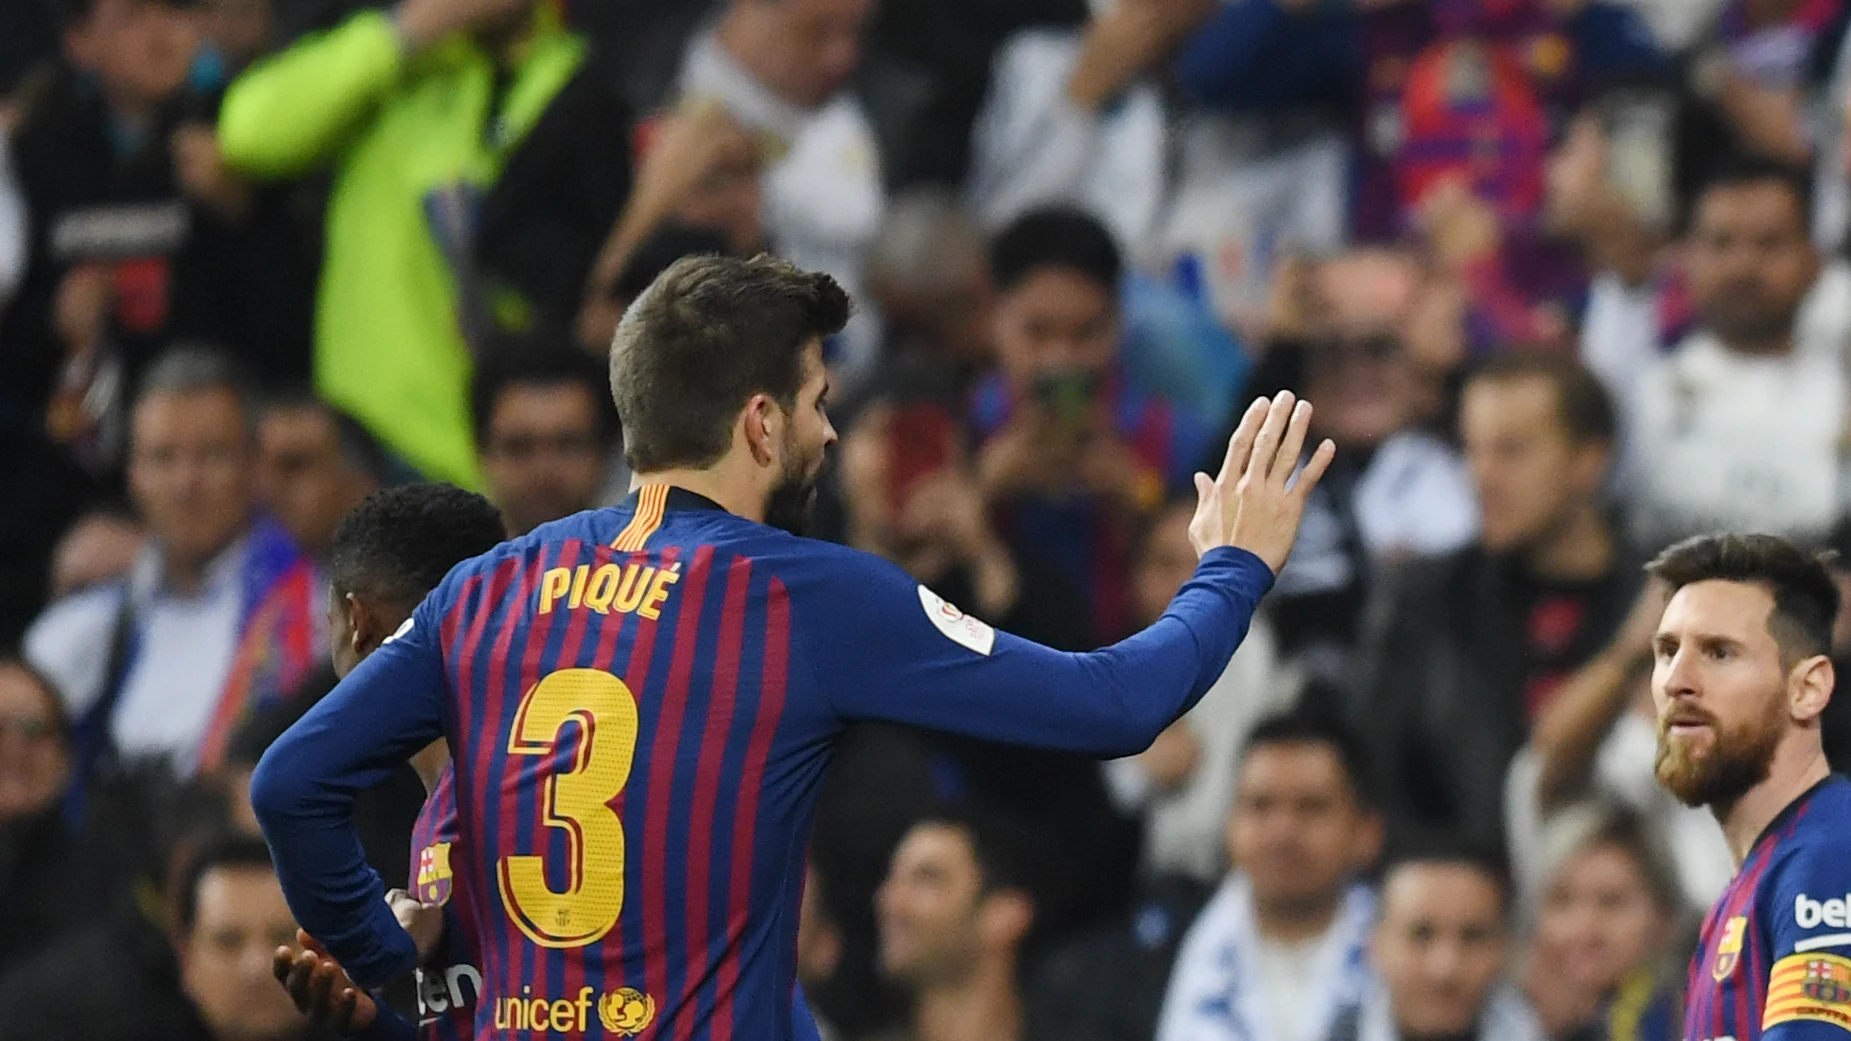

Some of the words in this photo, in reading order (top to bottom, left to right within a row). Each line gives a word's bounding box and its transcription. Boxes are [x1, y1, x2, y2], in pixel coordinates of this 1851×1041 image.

[538, 561, 682, 621] PIQUÉ
[496, 667, 639, 949] 3
[494, 984, 594, 1034] unicef
